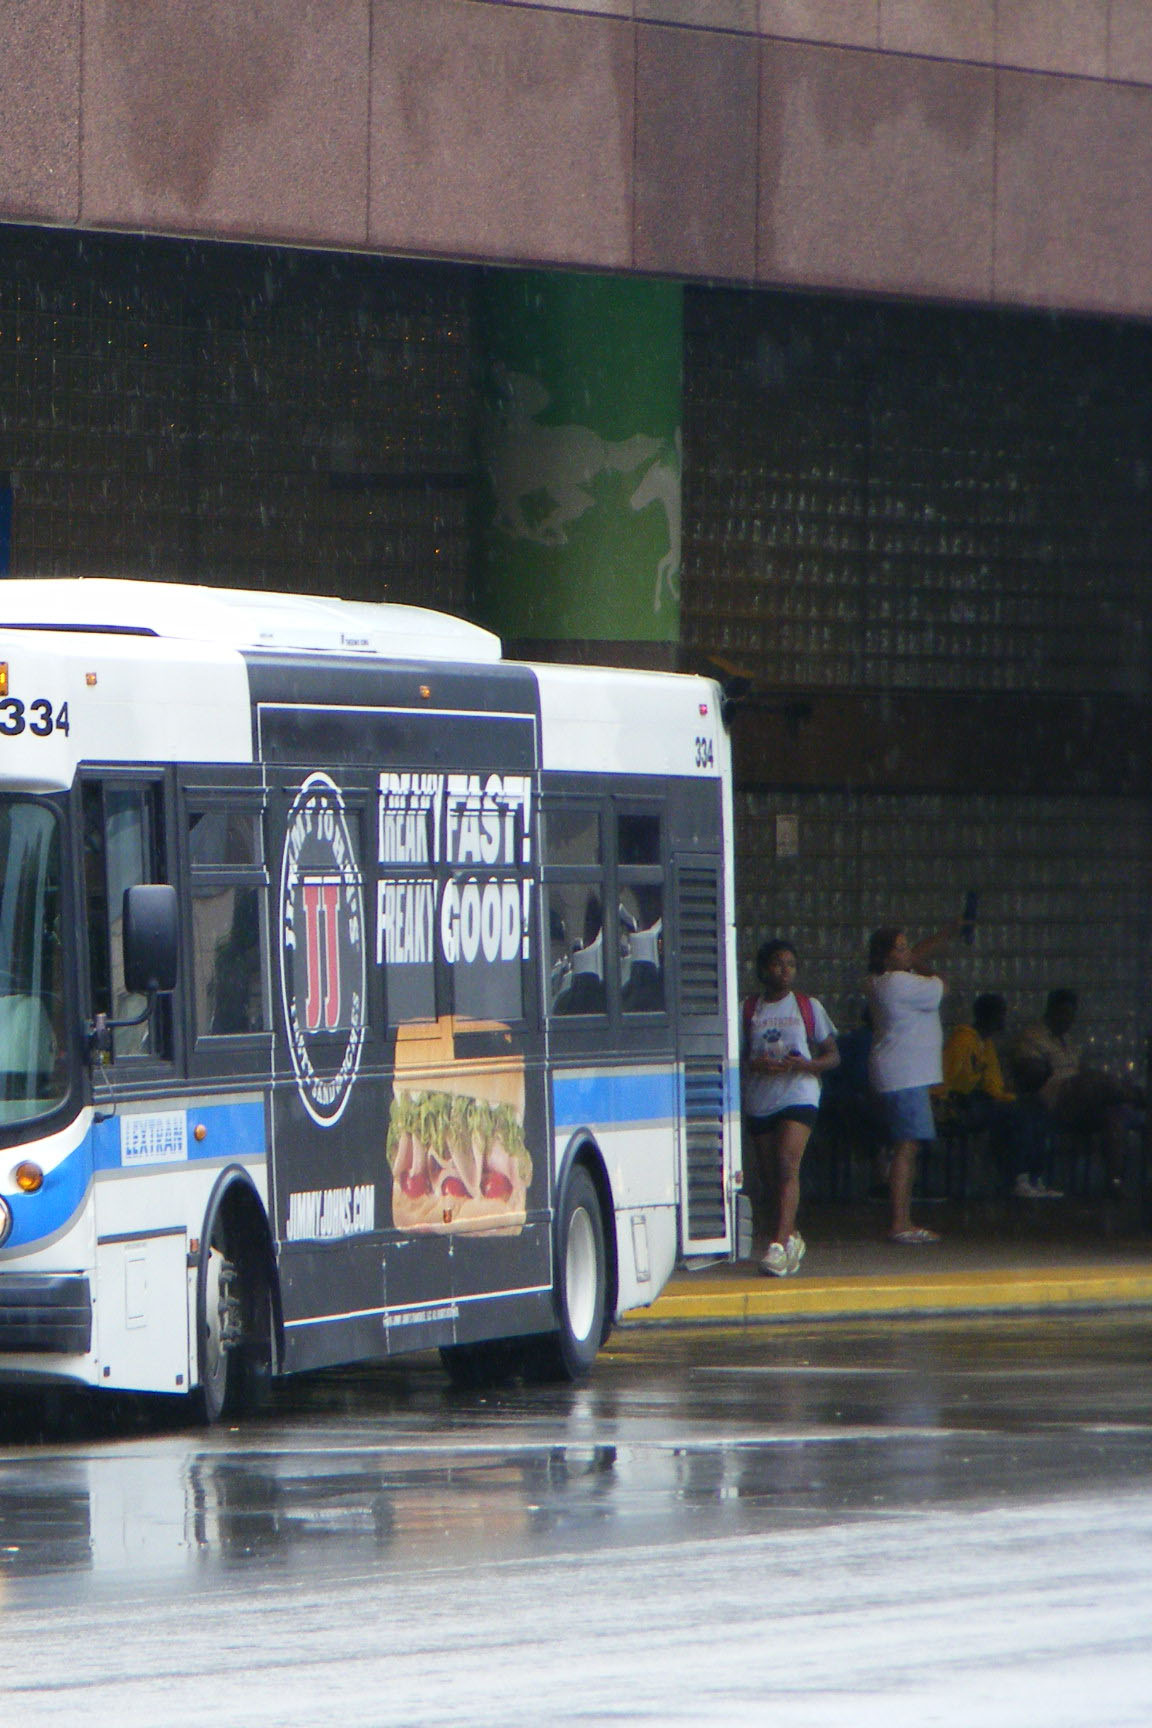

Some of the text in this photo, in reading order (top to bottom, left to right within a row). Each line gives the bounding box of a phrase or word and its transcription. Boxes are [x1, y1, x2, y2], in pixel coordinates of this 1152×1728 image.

[696, 736, 713, 768] 334
[378, 773, 532, 865] FREAKY FAST!
[376, 877, 535, 965] FREAKY GOOD!
